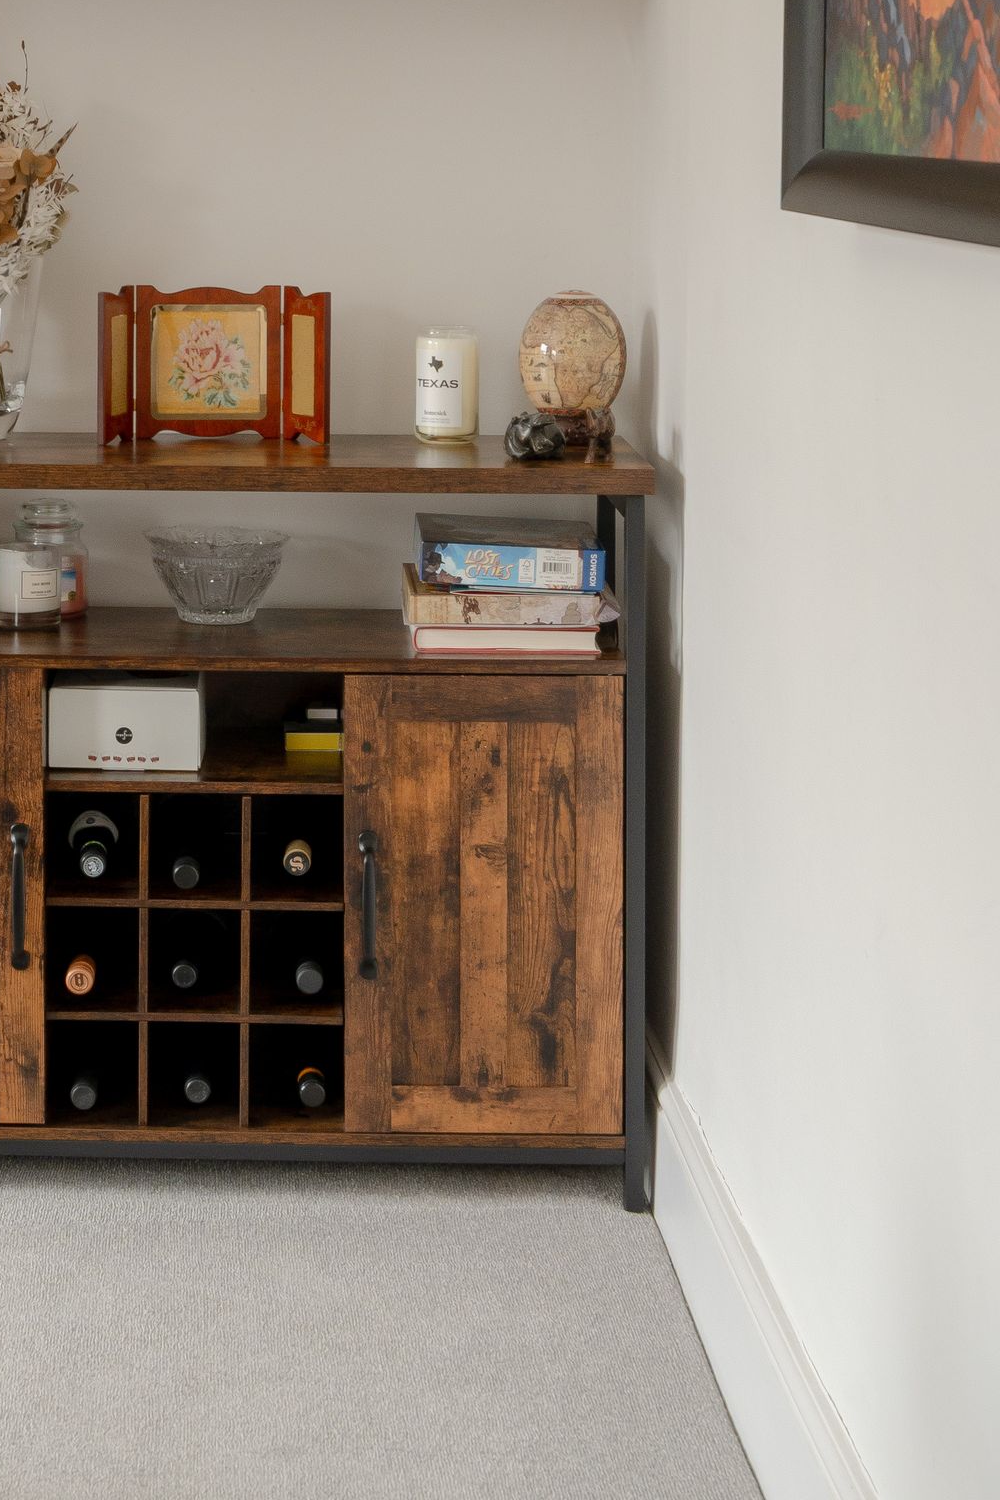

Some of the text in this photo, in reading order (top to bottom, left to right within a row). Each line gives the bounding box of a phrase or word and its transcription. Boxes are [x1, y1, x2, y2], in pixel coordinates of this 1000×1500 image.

[418, 378, 459, 388] TEXAS
[464, 549, 501, 565] LOST
[465, 564, 514, 580] CITIES
[589, 554, 598, 587] KOSMOS
